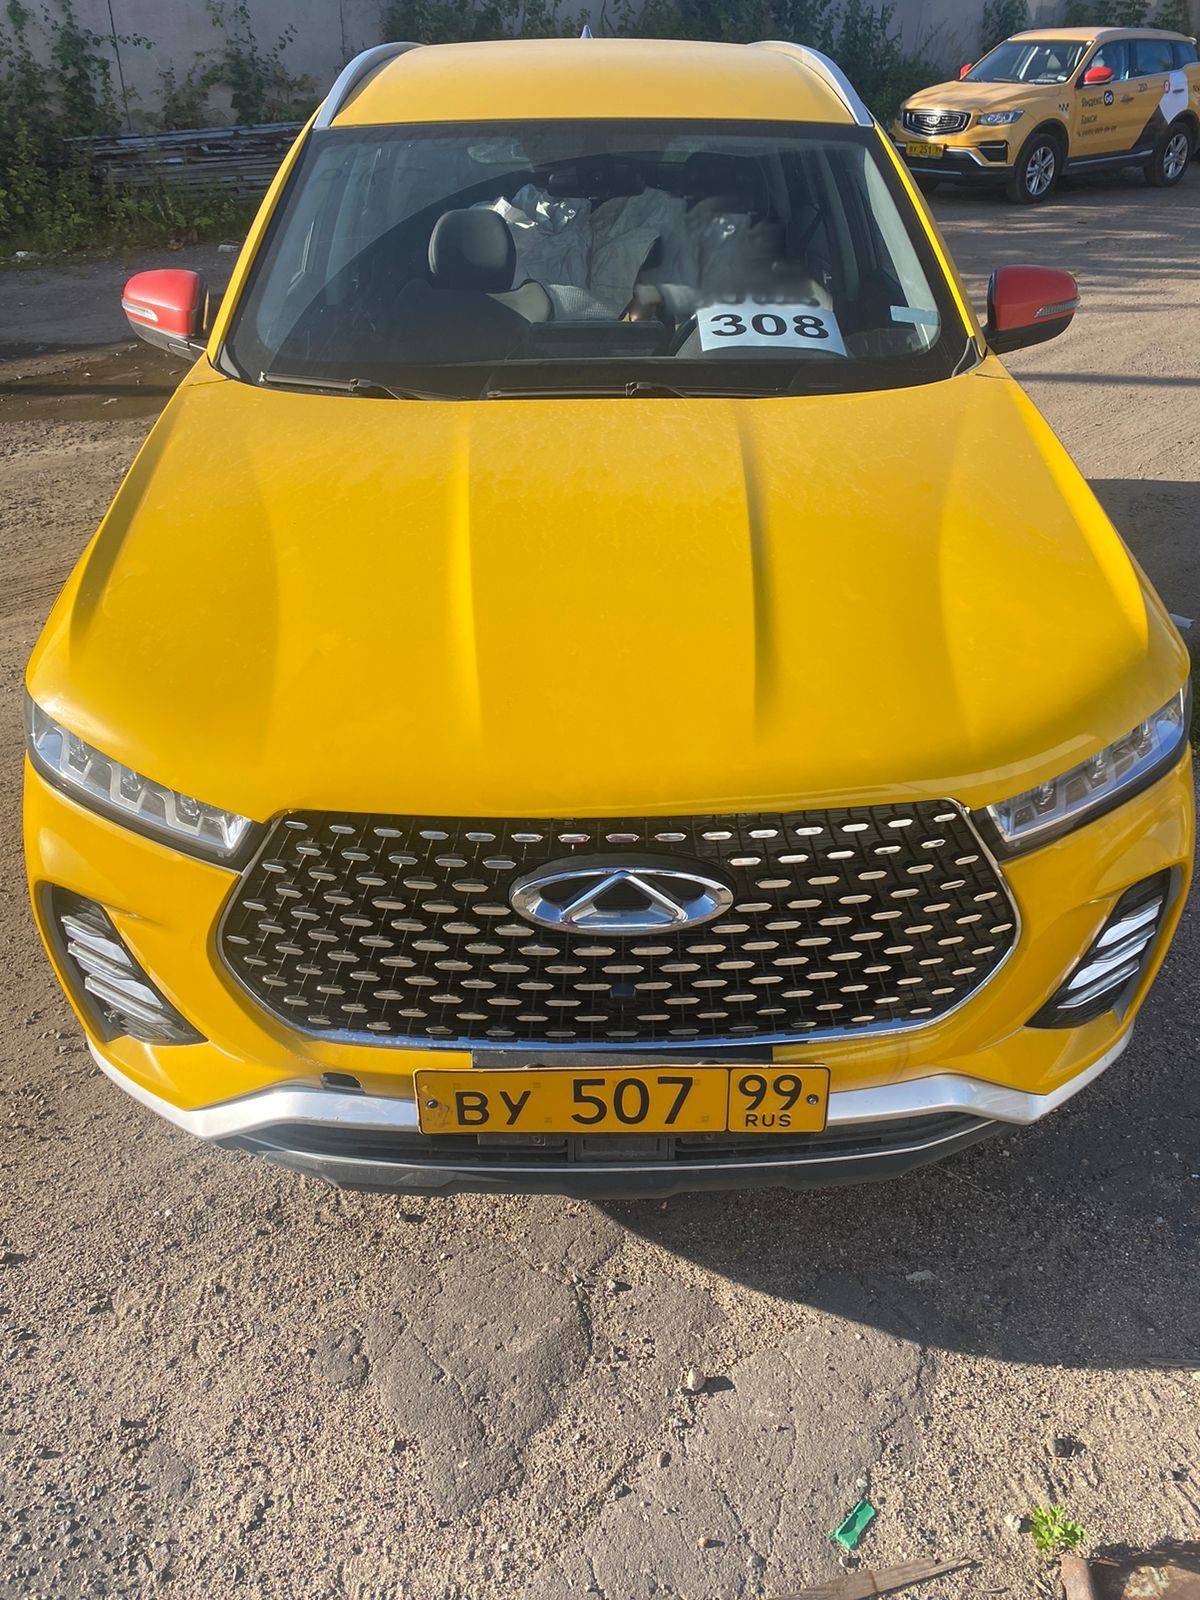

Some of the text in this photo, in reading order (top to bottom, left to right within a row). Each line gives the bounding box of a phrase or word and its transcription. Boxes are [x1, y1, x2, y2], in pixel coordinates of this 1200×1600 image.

[711, 313, 829, 339] 308
[571, 1076, 694, 1125] 507
[738, 1074, 803, 1111] 99
[744, 1112, 792, 1127] RUS
